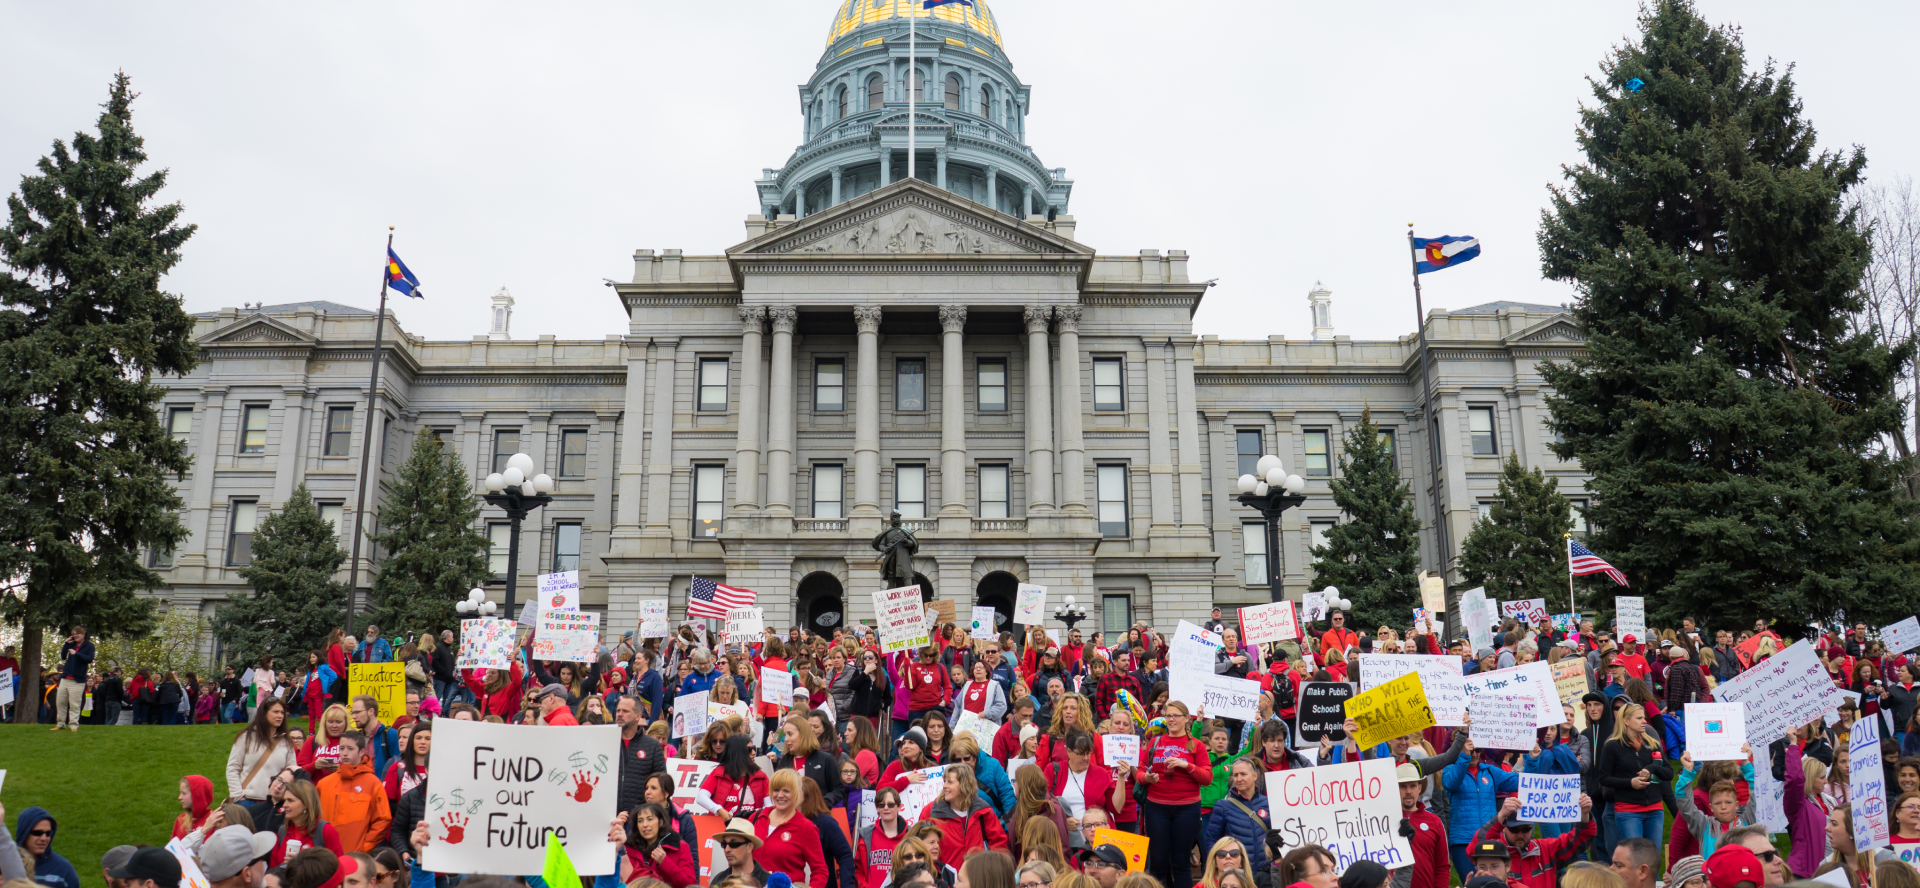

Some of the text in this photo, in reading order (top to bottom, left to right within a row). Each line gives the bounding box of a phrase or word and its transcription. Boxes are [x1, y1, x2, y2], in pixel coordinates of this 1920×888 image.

[886, 591, 901, 601] WORK
[904, 588, 919, 598] HARD
[1505, 600, 1531, 614] RED
[555, 613, 591, 621] REASONS
[726, 610, 756, 621] WHERE'S
[1243, 606, 1289, 623] Long Story
[1517, 607, 1545, 624] 4 ED
[726, 622, 740, 632] THE
[890, 619, 905, 627] WORK
[1246, 619, 1290, 633] Short Schools
[724, 632, 763, 644] FUNDING?
[1201, 630, 1210, 639] C
[1246, 634, 1260, 642] Need
[1260, 631, 1273, 639] More
[907, 639, 914, 647] US
[1361, 657, 1391, 666] Teacher
[351, 664, 403, 683] Educators
[1376, 670, 1395, 679] Pupil
[1463, 674, 1527, 696] It's time to
[1810, 677, 1831, 691] Billion
[1307, 687, 1348, 696] Make Public
[1346, 696, 1373, 715] WHO
[1380, 681, 1410, 699] WILL
[1720, 685, 1752, 703] Teacher
[1746, 693, 1766, 711] Pupil
[720, 706, 737, 715] Can
[1354, 694, 1423, 731] TEACH THE
[1470, 709, 1491, 719] Budget
[1688, 705, 1706, 714] Now
[1789, 715, 1801, 725] are
[1802, 705, 1821, 719] going
[1821, 700, 1830, 710] to
[1302, 722, 1343, 734] Great Again
[1360, 706, 1433, 745] CHILDREN?
[1470, 726, 1493, 735] Knowing
[1515, 728, 1532, 736] going
[1850, 717, 1876, 749] IOU
[1488, 740, 1528, 749] PRICELESS!
[1690, 741, 1707, 750] Fund
[474, 746, 544, 782] FUND
[1853, 753, 1878, 777] promise
[1284, 762, 1382, 807] Colorado
[1521, 777, 1580, 790] LIVING WAGES
[1851, 779, 1882, 800] I will pay
[496, 789, 535, 806] our
[1527, 792, 1571, 804] FOR OUR
[1521, 805, 1578, 819] EDUCATORS
[1852, 801, 1882, 826] you later
[487, 812, 568, 849] Future
[1284, 808, 1394, 849] Stop Failing
[1100, 834, 1134, 848] Teachers
